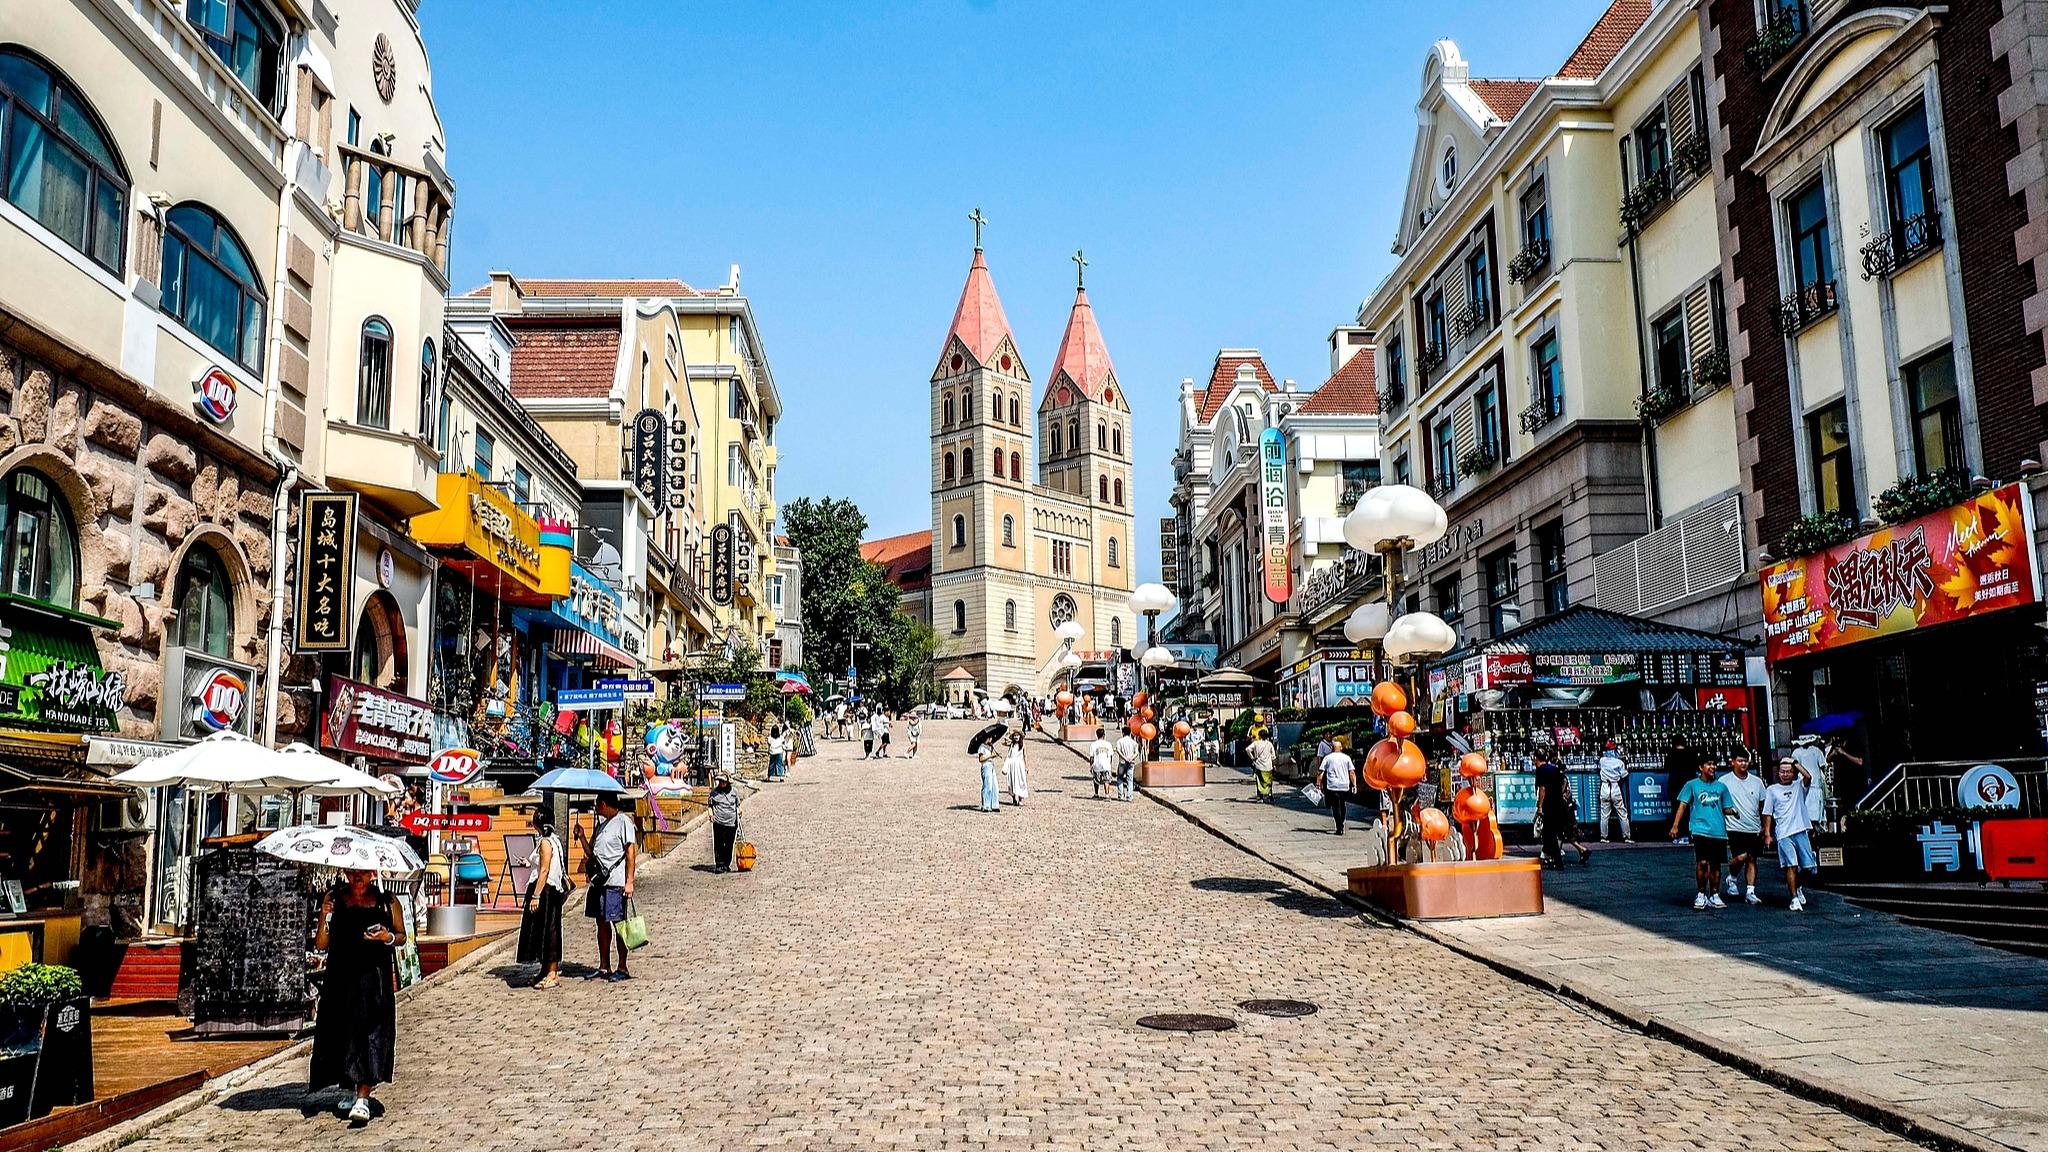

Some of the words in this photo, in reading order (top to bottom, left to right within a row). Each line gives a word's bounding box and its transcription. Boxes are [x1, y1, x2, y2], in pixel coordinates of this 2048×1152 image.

[206, 376, 233, 412] DQ
[1264, 439, 1284, 507] 前海沿
[1943, 515, 1978, 562] Meet
[314, 506, 338, 637] 岛城十大名吃
[1267, 525, 1287, 586] 青岛菜
[1828, 525, 1934, 632] 遇见秋天
[1974, 581, 2020, 601] 美好如期而至
[1979, 568, 2009, 586] 邂逅秋日
[1768, 618, 1793, 637] 青岛特产
[1795, 609, 1823, 628] 山东特产
[1782, 629, 1809, 646] 一站购齐
[208, 682, 241, 720] DQ
[45, 709, 93, 726] HANDMADE
[95, 717, 110, 728] TEA
[437, 755, 474, 775] DQ
[413, 816, 430, 827] DQ
[433, 818, 482, 827] 在中山路等你
